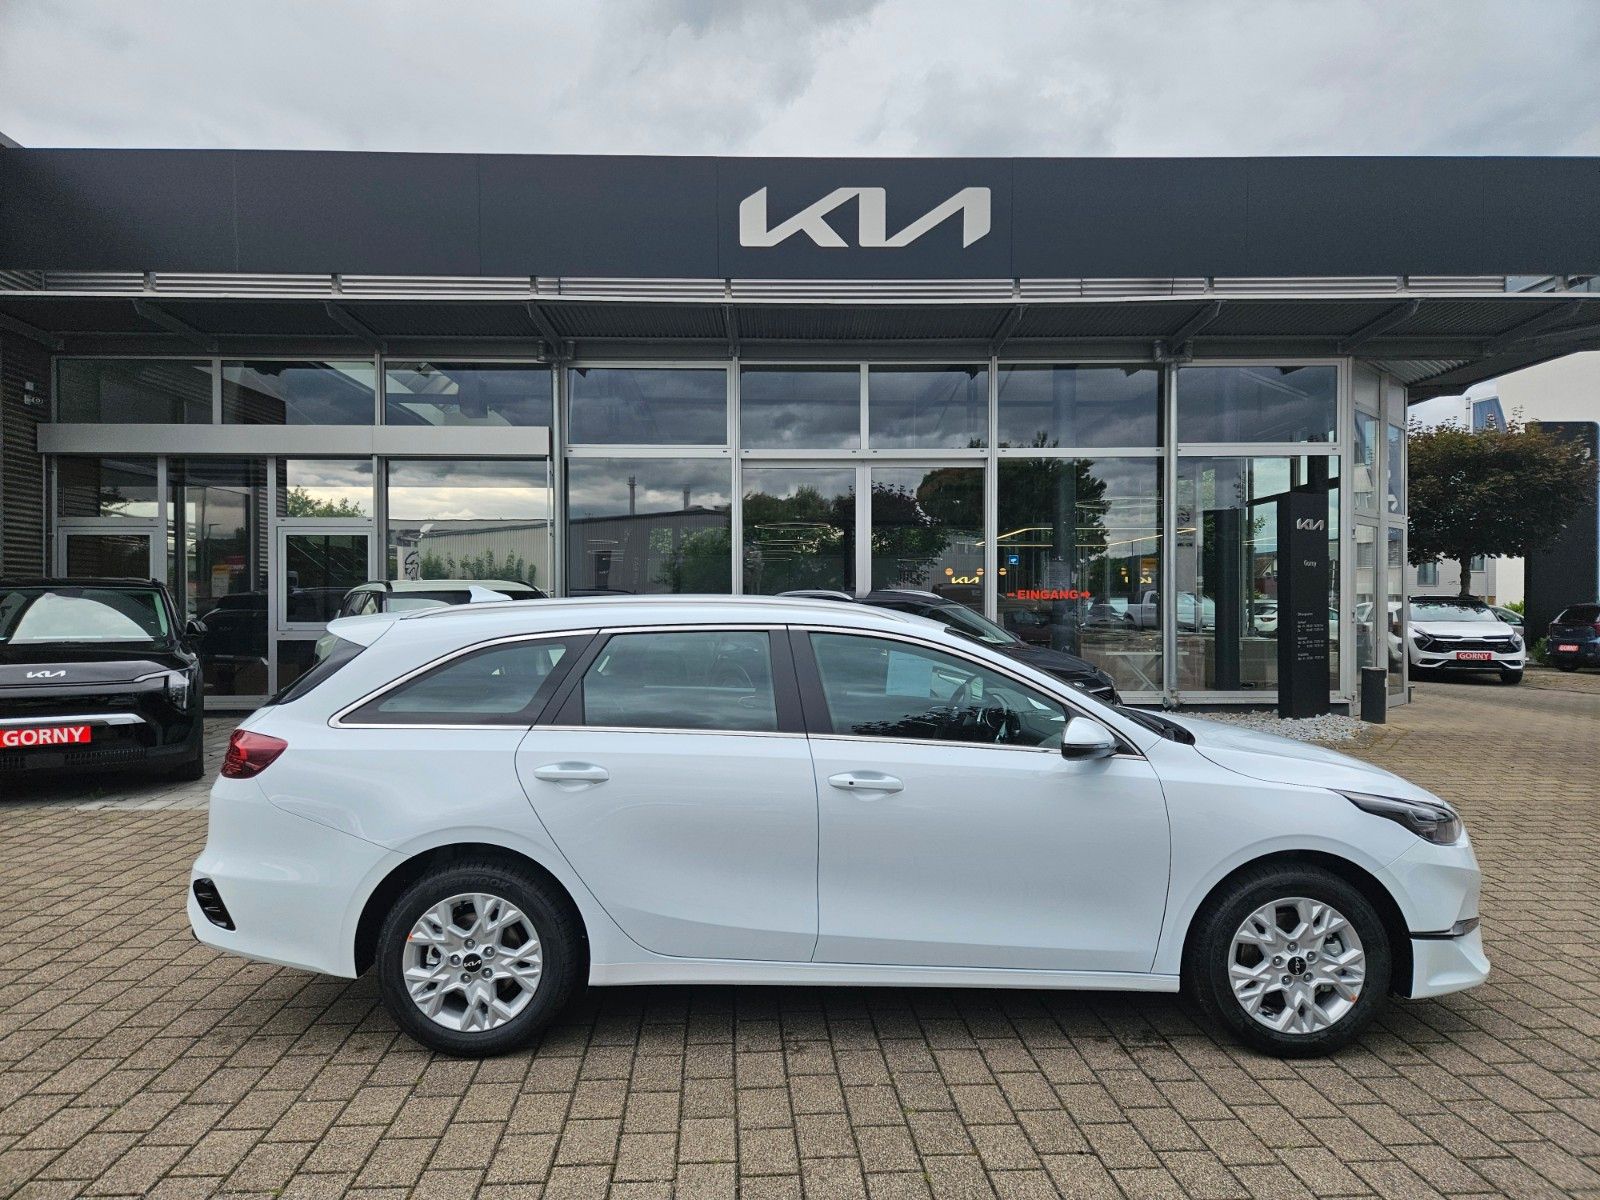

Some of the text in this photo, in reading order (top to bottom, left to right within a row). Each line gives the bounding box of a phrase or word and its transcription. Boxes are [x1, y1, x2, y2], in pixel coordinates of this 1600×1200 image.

[739, 186, 991, 248] KIA
[1296, 518, 1324, 530] KIA
[951, 576, 979, 584] KIA
[1017, 590, 1079, 600] EINGANG
[1459, 652, 1490, 660] GORNY
[26, 670, 66, 678] KIA
[2, 726, 85, 747] GORNY
